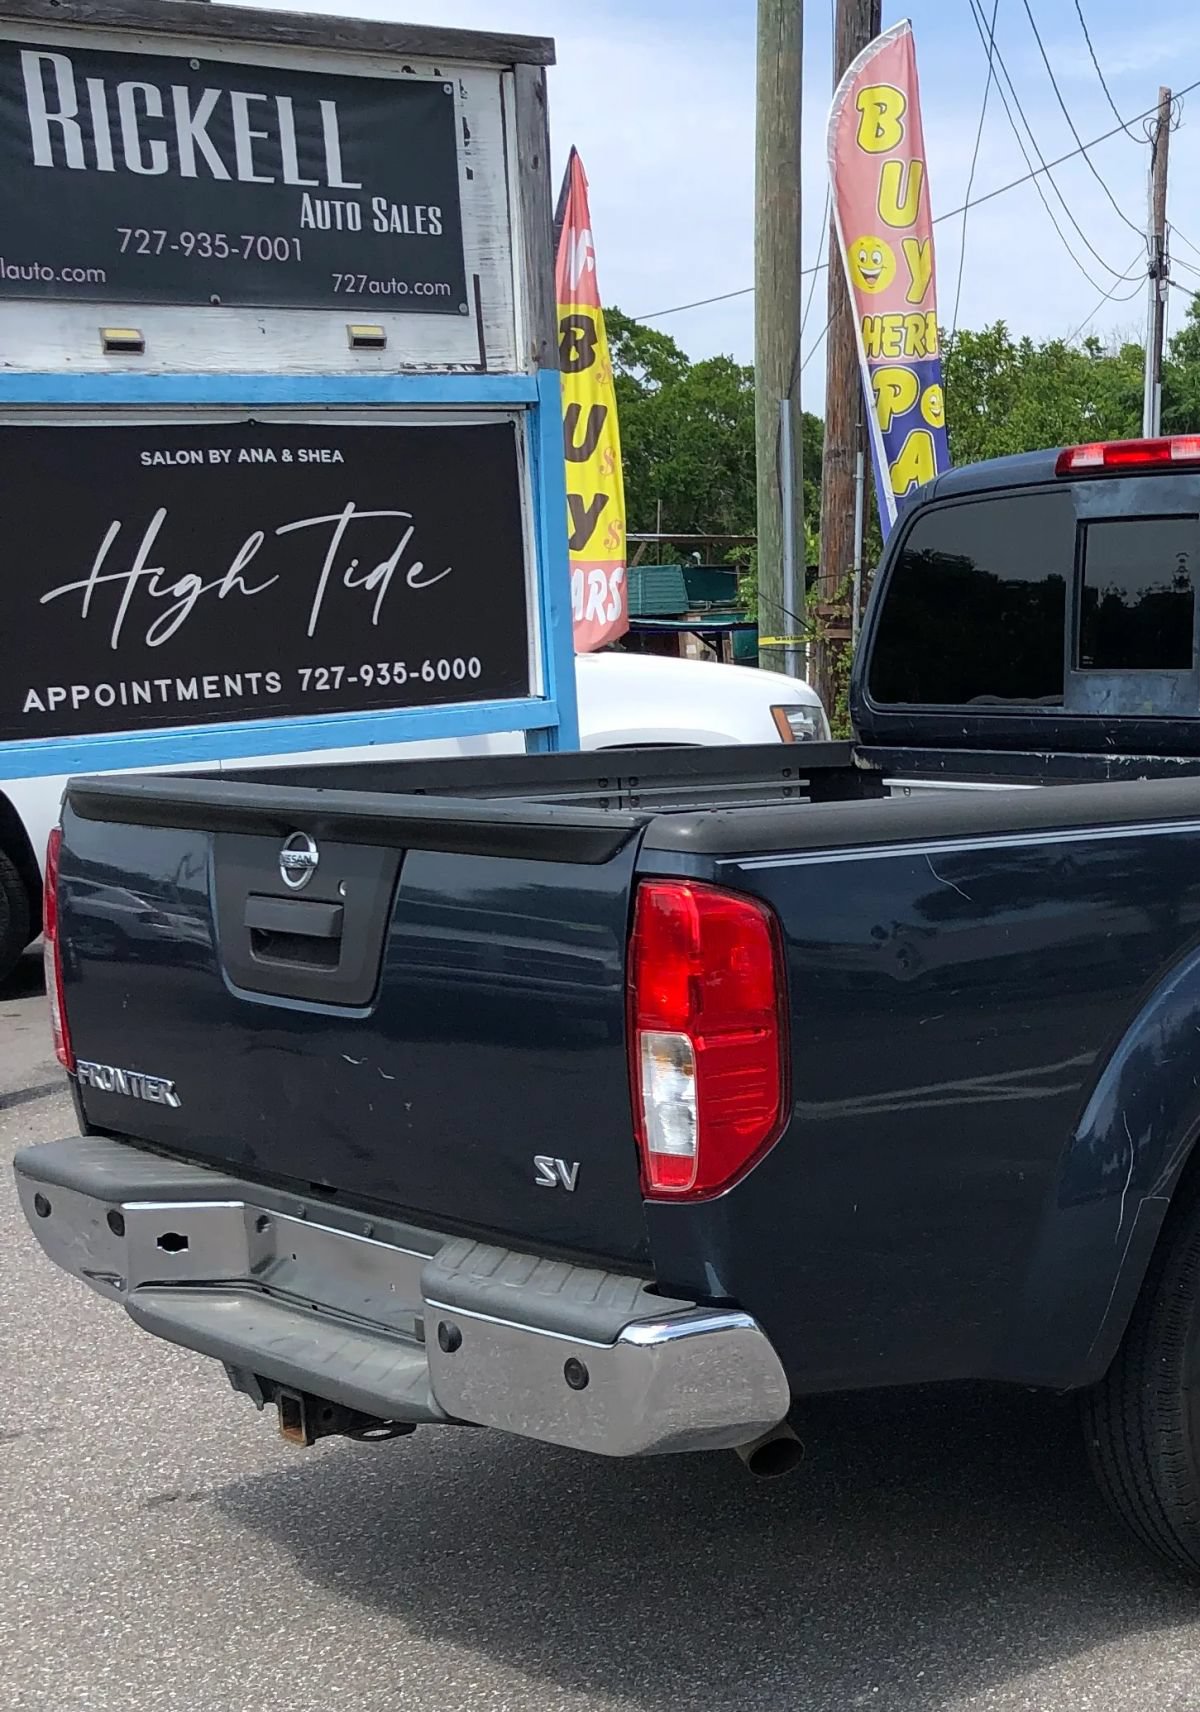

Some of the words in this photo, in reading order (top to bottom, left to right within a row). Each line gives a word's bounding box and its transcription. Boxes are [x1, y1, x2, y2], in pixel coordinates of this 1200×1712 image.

[116, 227, 302, 262] 727-935-7001
[331, 273, 451, 296] 727auto.com
[140, 450, 204, 466] SALON
[208, 449, 232, 464] BY
[238, 448, 277, 463] ANA
[281, 449, 293, 463] &
[297, 449, 345, 464] SHEA
[39, 507, 280, 650] High
[275, 501, 452, 638] Tide
[22, 670, 283, 713] APPOINTMENTS
[297, 656, 483, 692] 727-935-6000
[76, 1059, 182, 1108] FRONTIER
[533, 1155, 580, 1192] SV
